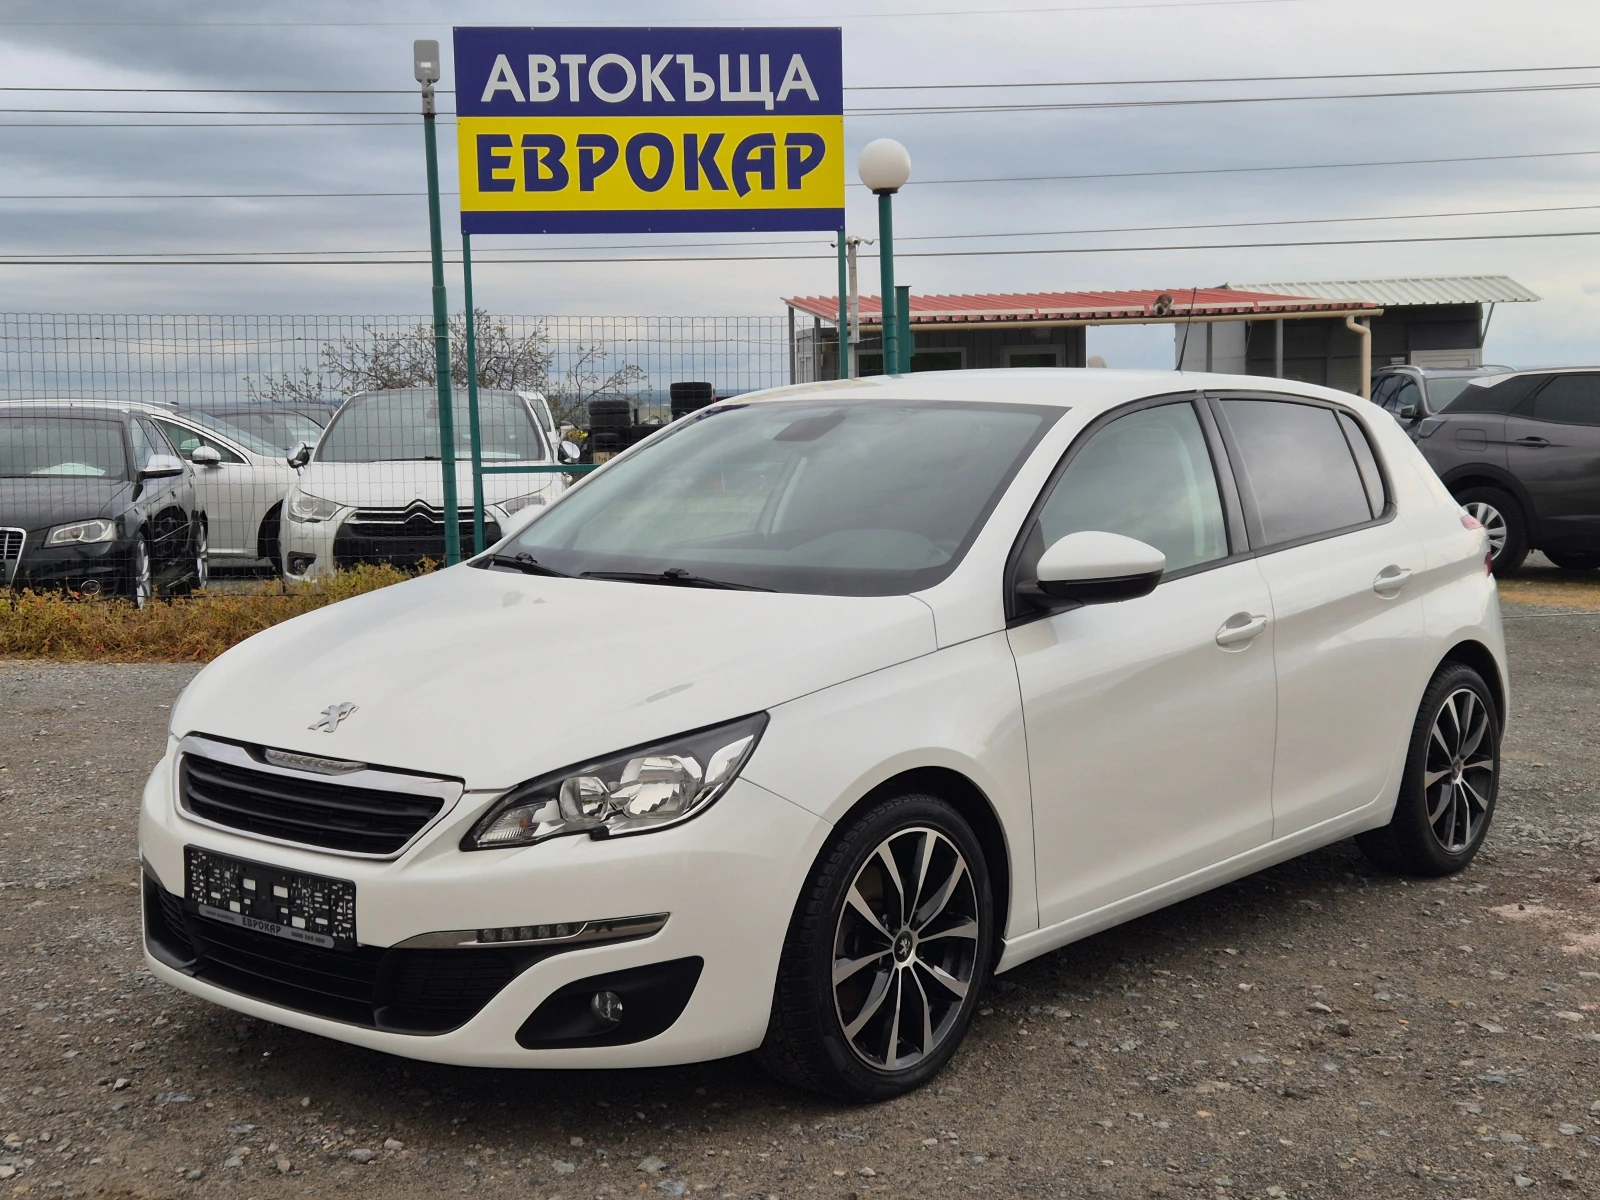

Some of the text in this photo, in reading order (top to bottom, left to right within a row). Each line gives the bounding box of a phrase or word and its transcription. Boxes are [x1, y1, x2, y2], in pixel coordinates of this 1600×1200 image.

[480, 53, 820, 111] АВТОКЪЩА
[475, 132, 826, 198] ЕВРОКАР
[241, 917, 282, 934] ЕВРОКАР
